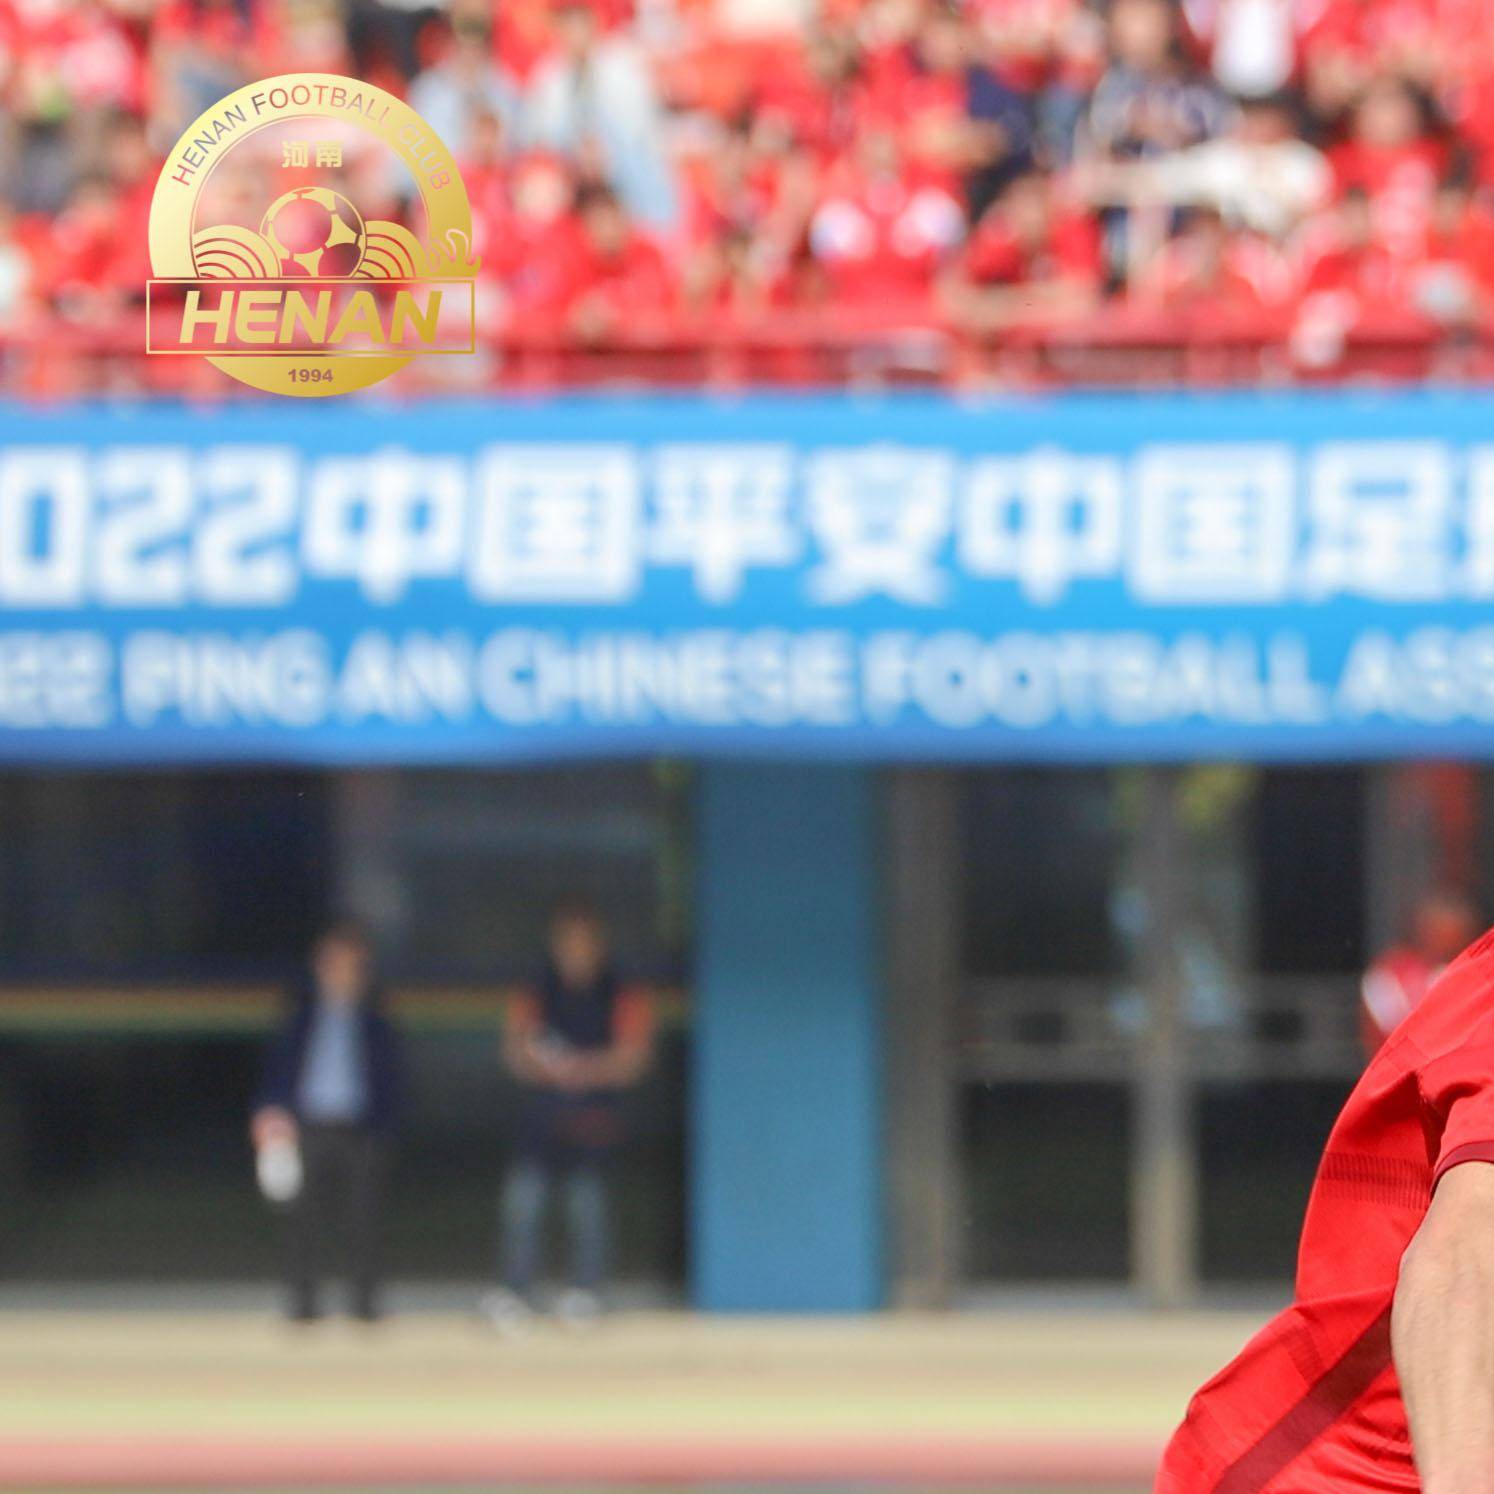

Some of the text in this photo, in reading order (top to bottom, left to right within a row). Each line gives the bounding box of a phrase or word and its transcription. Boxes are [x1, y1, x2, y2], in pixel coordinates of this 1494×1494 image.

[120, 627, 333, 728] PING
[336, 628, 475, 725] AN
[479, 626, 859, 728] CHINESE
[862, 627, 1331, 730] FOOTBALL
